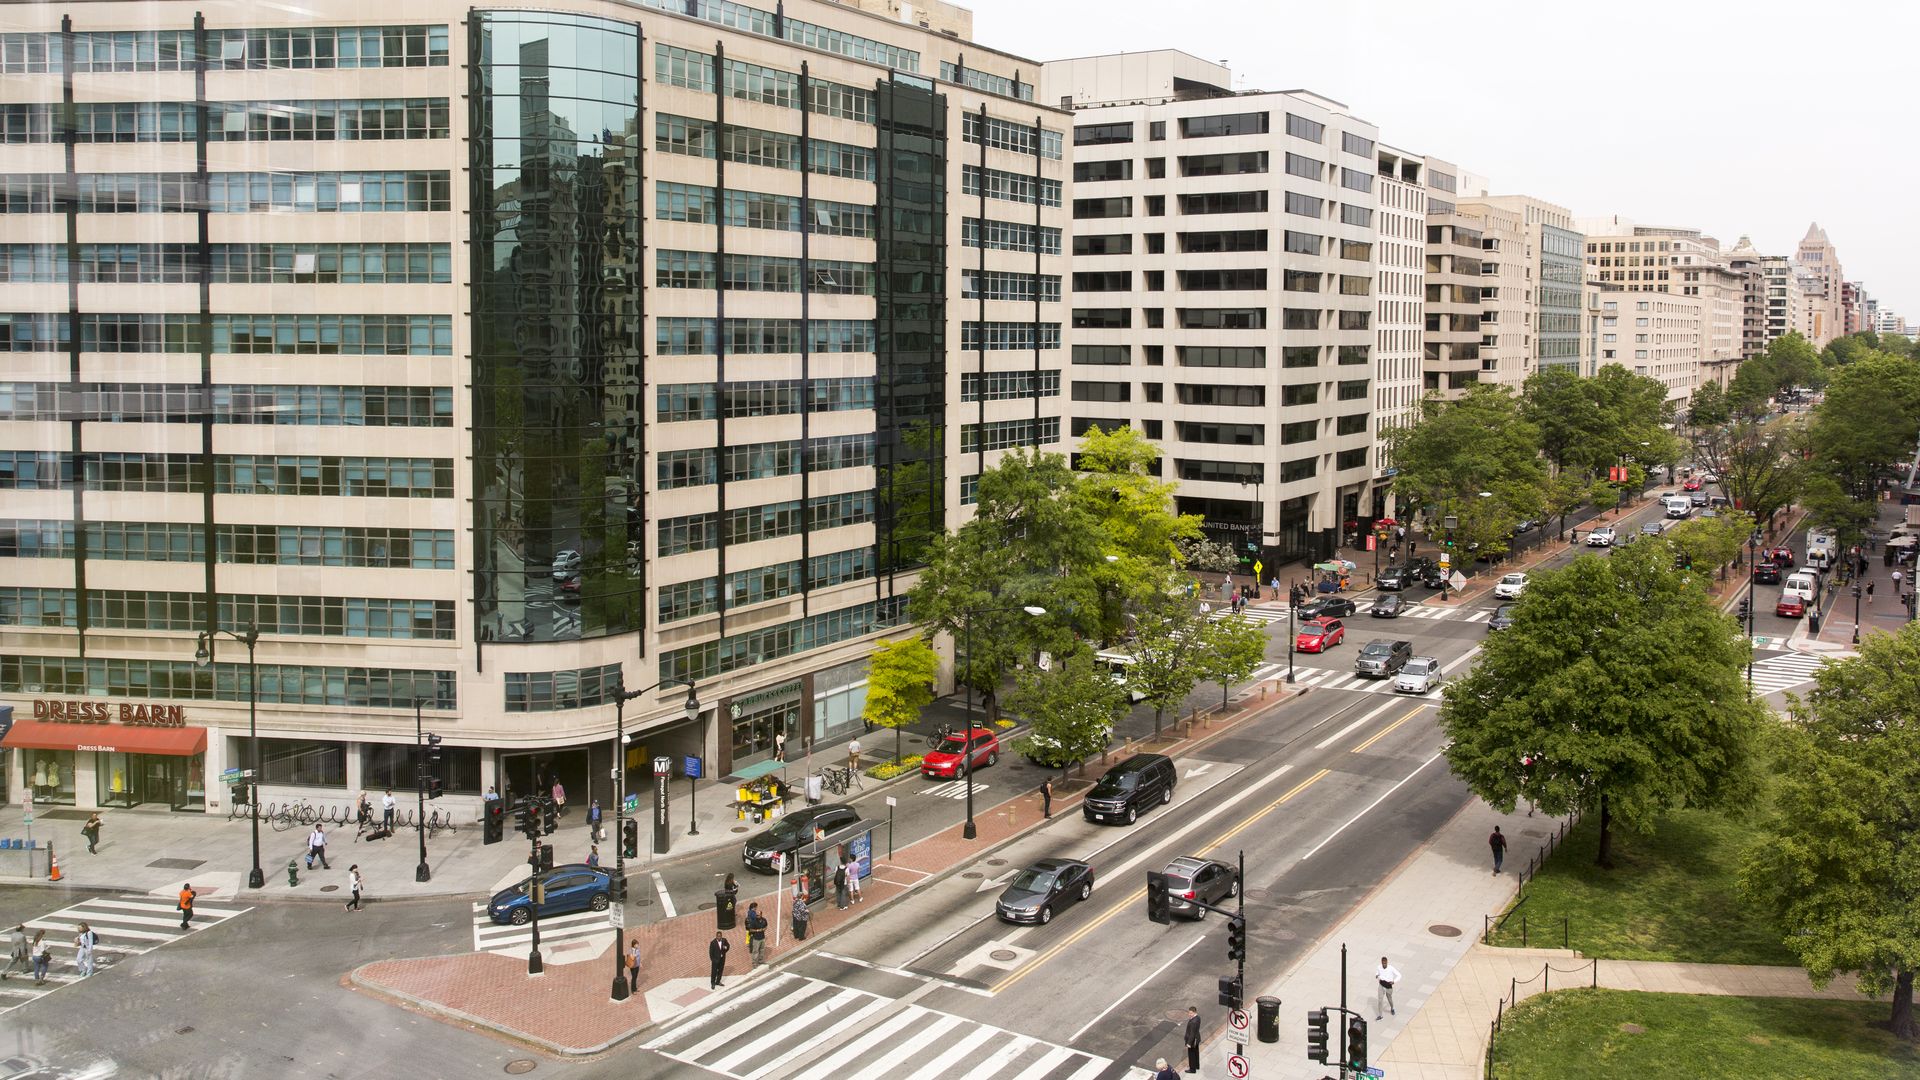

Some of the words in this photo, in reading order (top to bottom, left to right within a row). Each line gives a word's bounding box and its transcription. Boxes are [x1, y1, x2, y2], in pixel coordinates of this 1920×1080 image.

[1203, 522, 1229, 530] UNITED
[1230, 523, 1250, 532] BANK
[33, 699, 110, 722] DRESS
[119, 702, 185, 725] BARN
[654, 760, 666, 773] M
